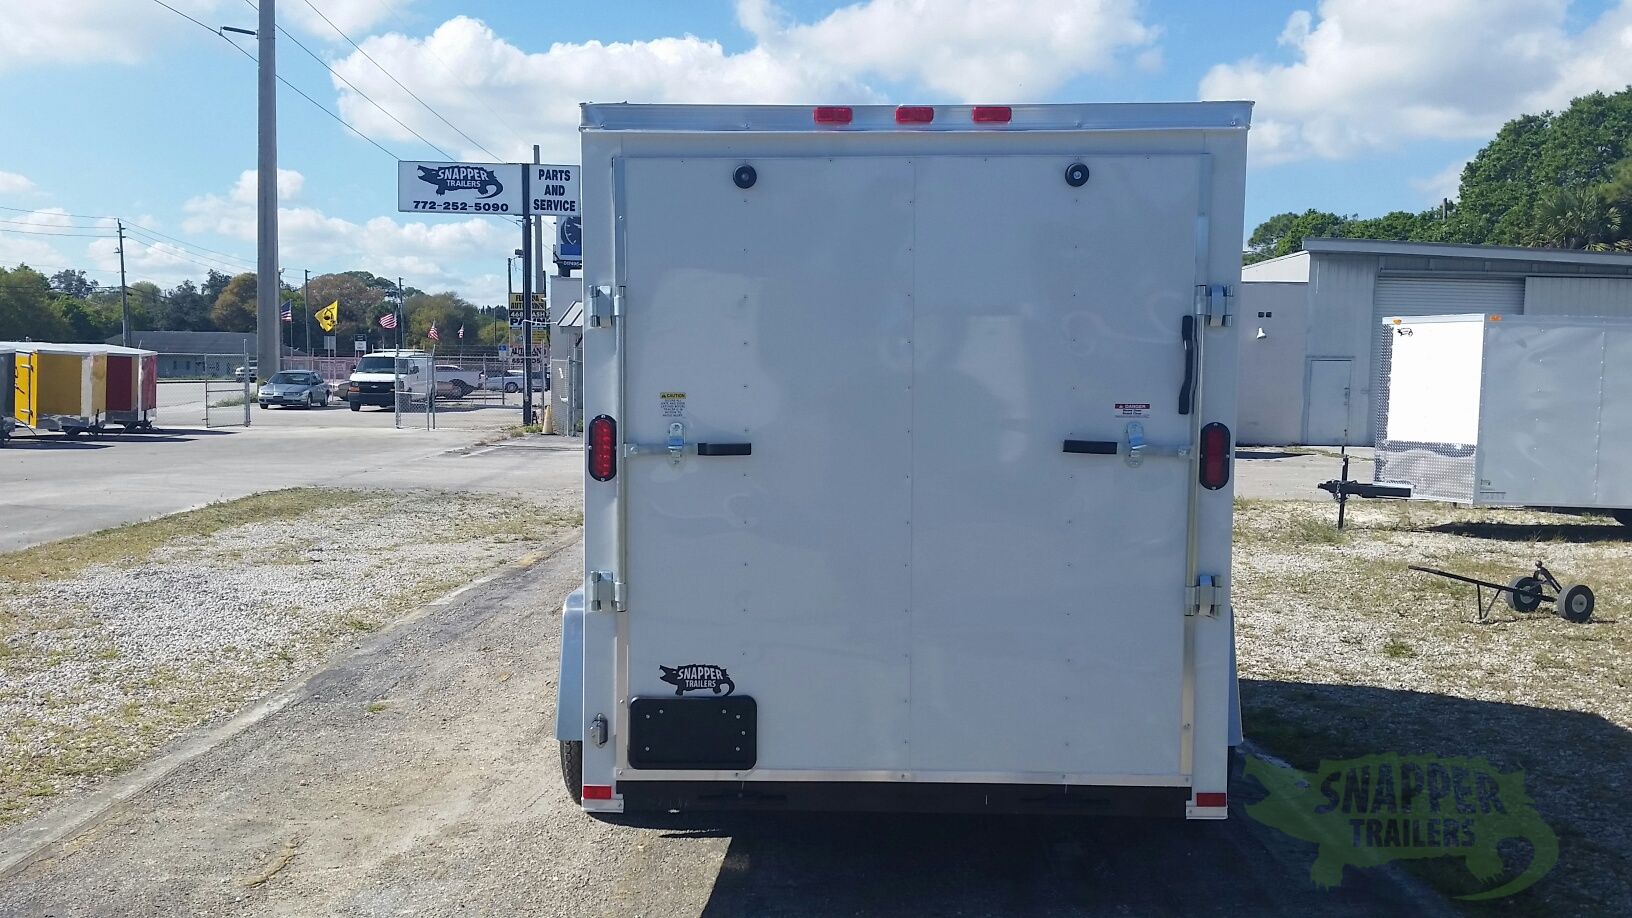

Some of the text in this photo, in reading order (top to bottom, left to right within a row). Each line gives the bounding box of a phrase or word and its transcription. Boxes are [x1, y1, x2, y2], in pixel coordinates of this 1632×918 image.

[437, 167, 489, 181] SNAPPER
[538, 169, 571, 181] PARTS
[446, 180, 481, 188] TRAILERS
[544, 185, 565, 196] AND
[413, 200, 509, 212] 772-252-5090
[533, 199, 576, 212] SERVICE
[677, 667, 723, 680] SNAPPER
[685, 680, 716, 688] TRAILERS
